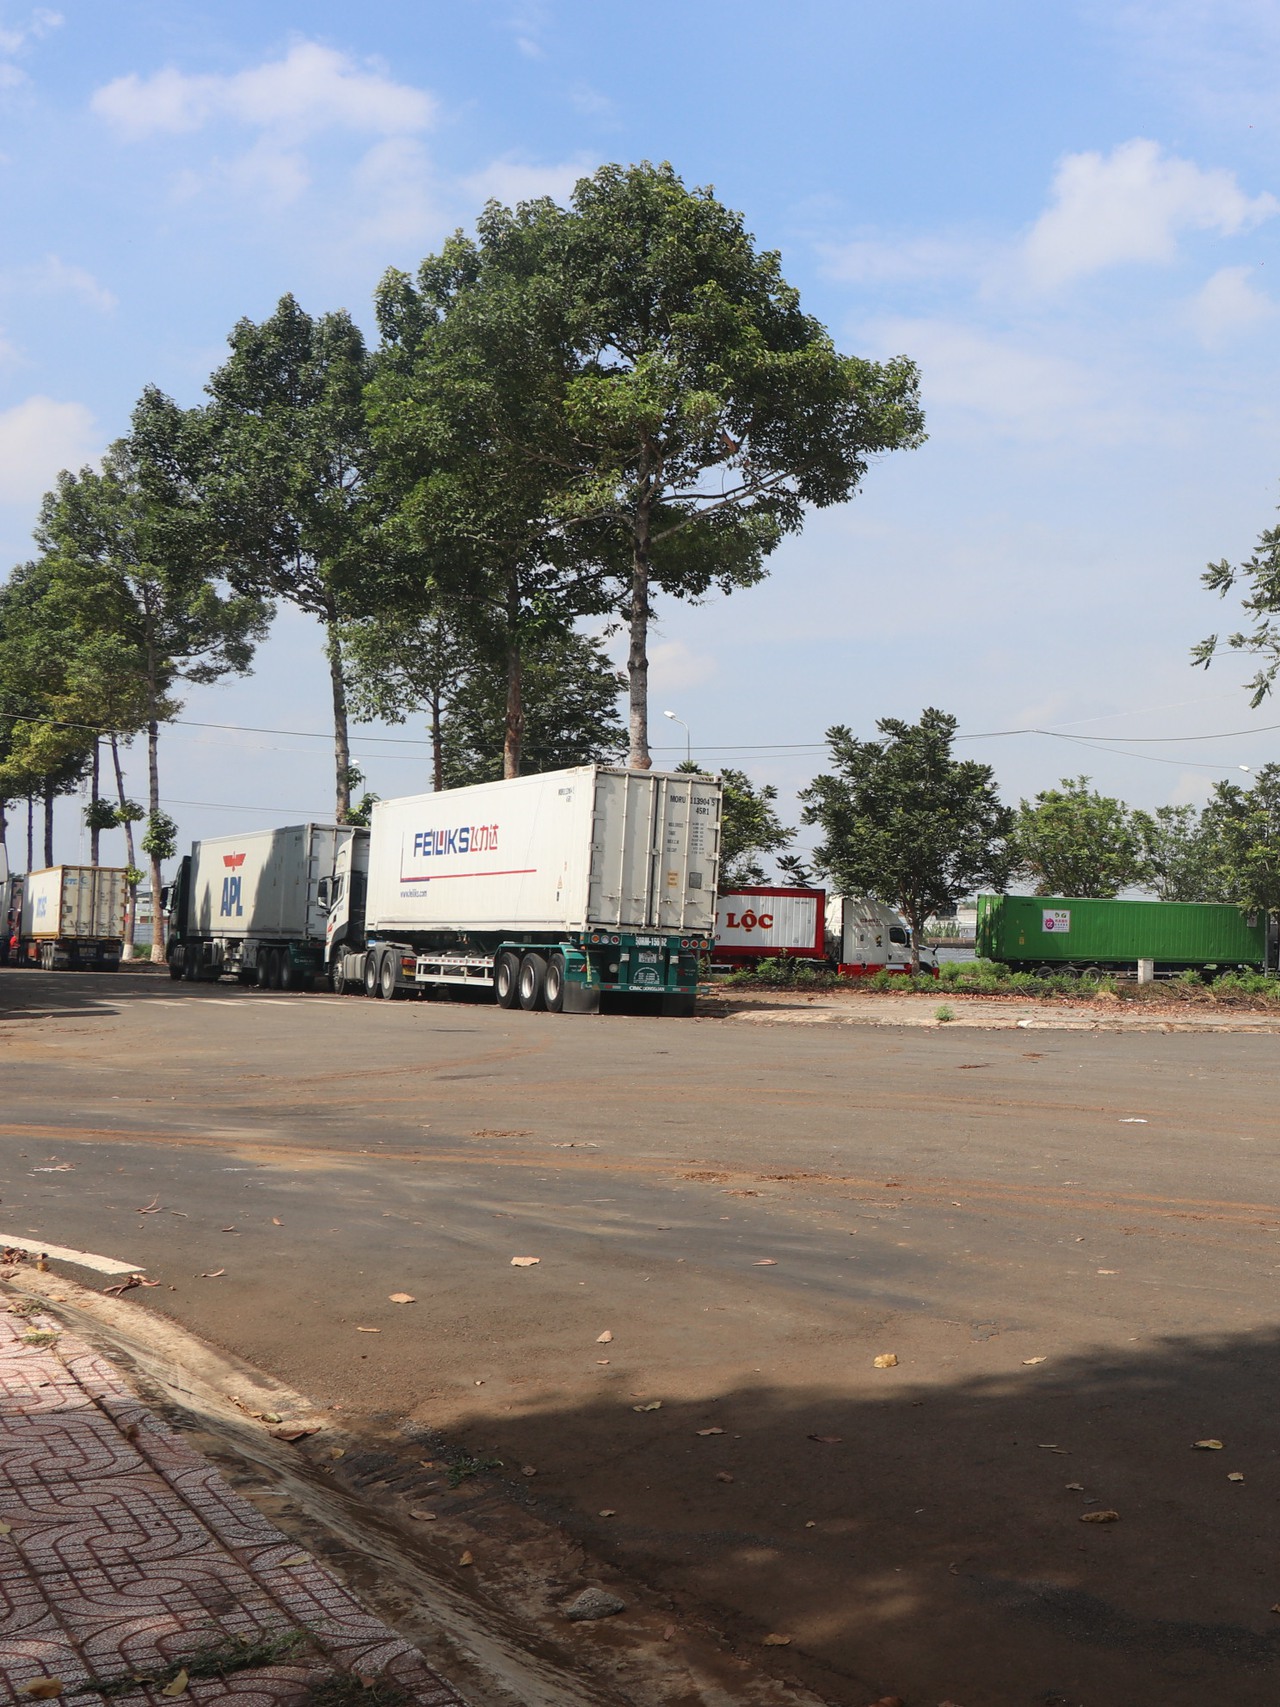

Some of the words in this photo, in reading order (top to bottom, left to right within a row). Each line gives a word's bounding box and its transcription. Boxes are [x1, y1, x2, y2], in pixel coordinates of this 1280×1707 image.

[413, 827, 470, 858] FEILIKS
[220, 876, 243, 917] APL
[726, 908, 774, 933] LỘC
